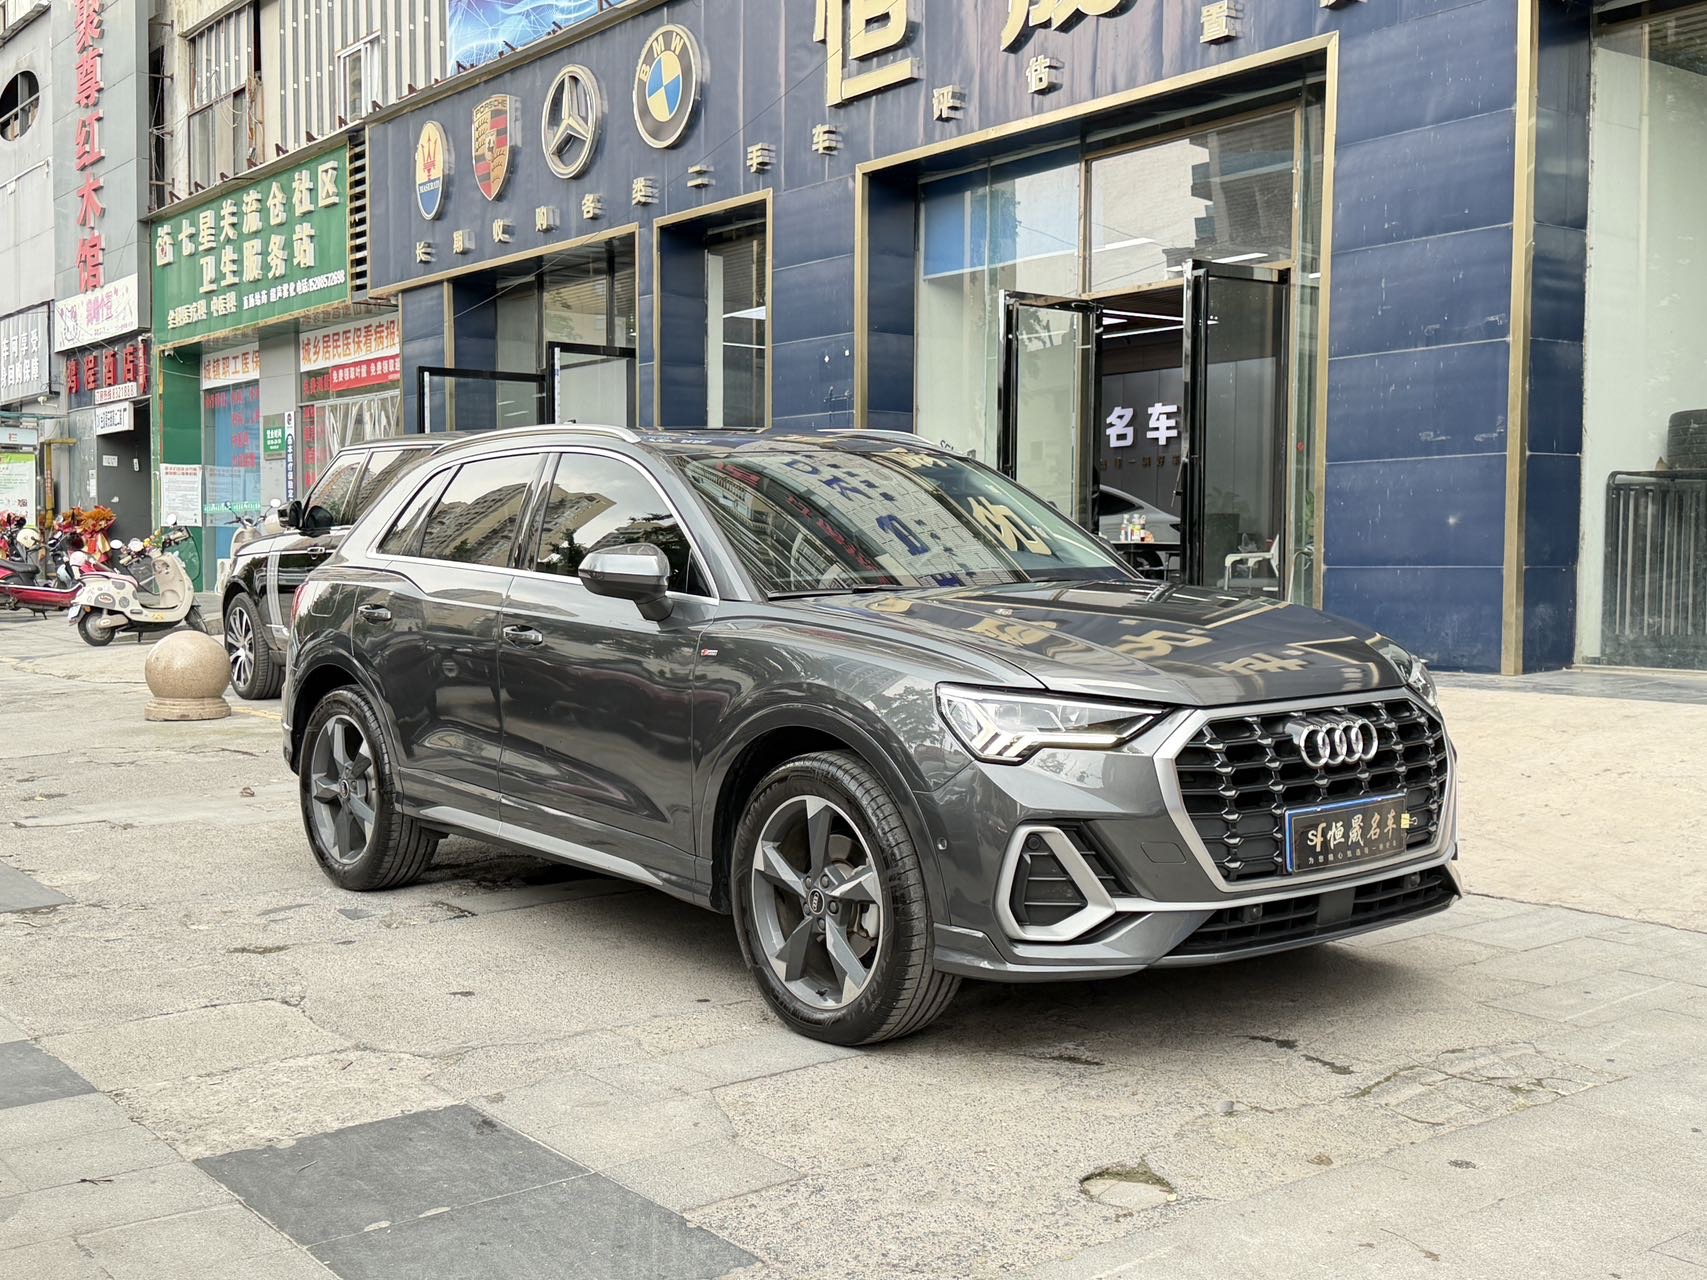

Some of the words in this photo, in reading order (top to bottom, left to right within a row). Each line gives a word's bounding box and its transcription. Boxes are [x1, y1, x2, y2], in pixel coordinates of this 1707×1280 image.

[639, 32, 684, 82] BMW
[475, 99, 507, 118] PORSCHE
[415, 124, 844, 263] 长期收购各类二手车
[199, 224, 315, 293] 卫生服务站
[1105, 402, 1178, 448] 名车
[286, 434, 294, 502] 基本医疗保险定
[1327, 808, 1397, 850] 恒晟名车
